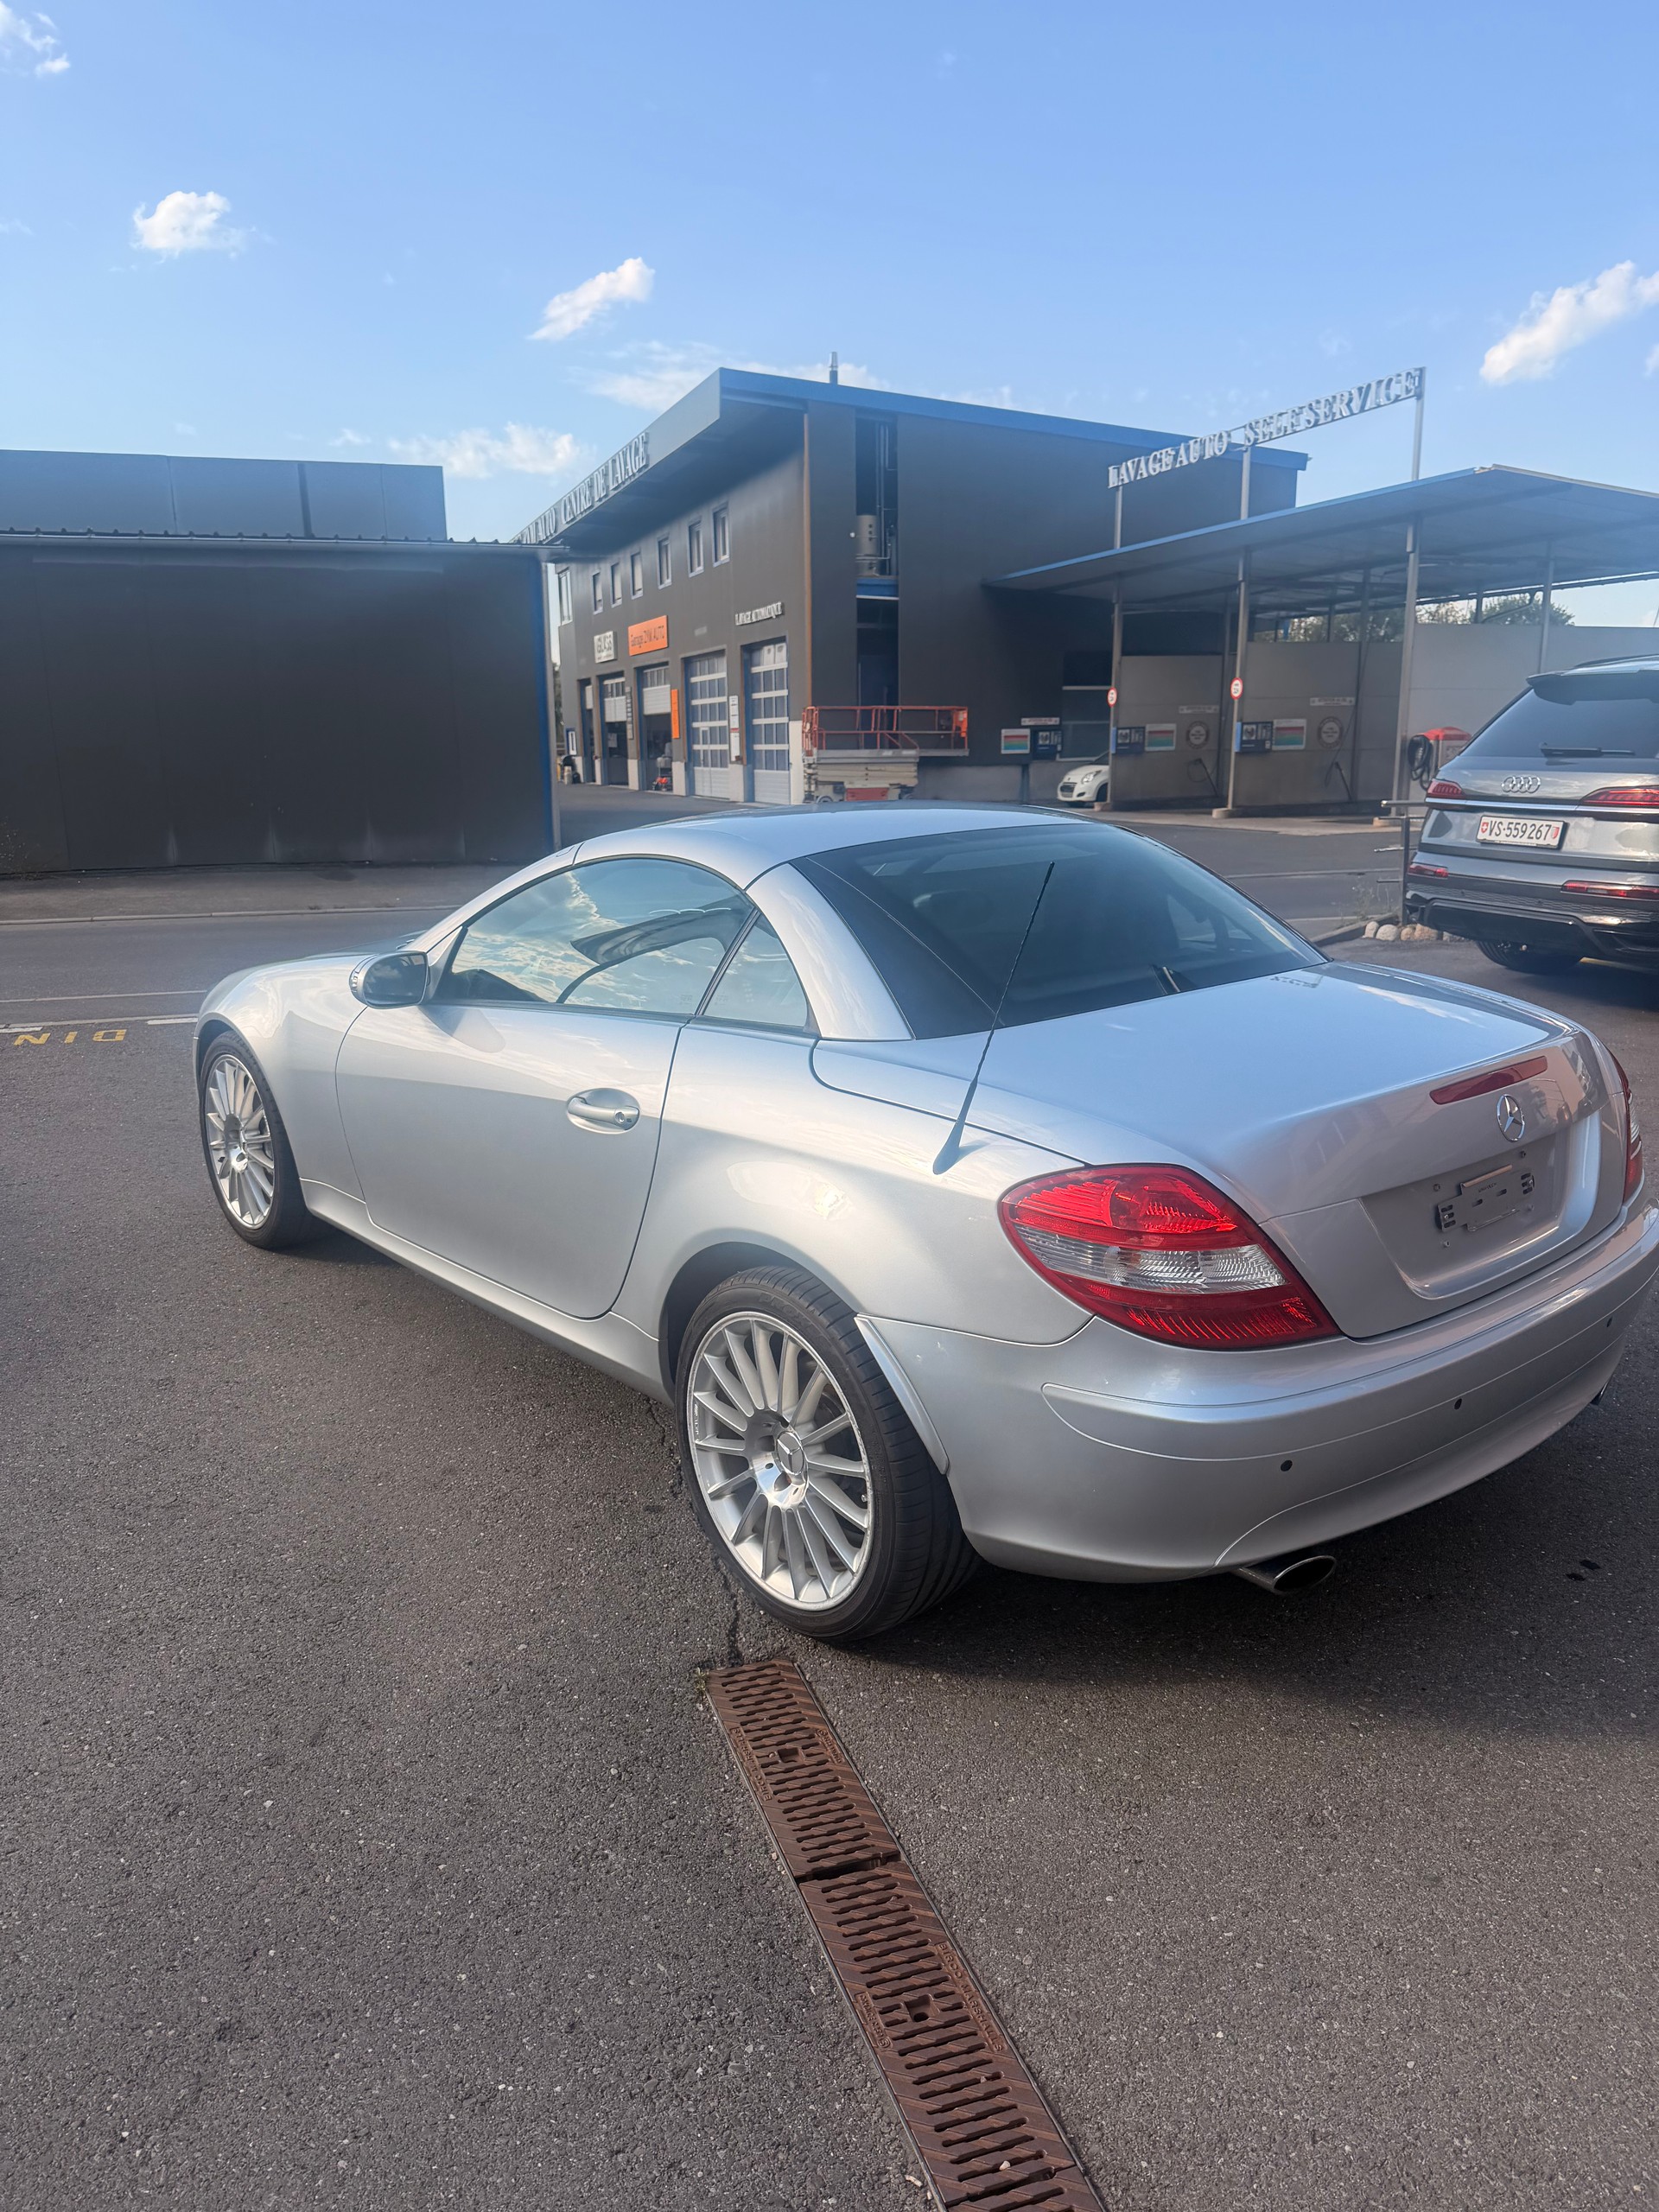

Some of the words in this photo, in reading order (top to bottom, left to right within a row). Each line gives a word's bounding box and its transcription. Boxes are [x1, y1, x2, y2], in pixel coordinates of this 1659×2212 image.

[1108, 449, 1175, 488] LAVAGE
[1175, 430, 1229, 468] AUTO
[1303, 368, 1415, 429] SERVICE
[561, 478, 593, 524] CENTRE
[594, 465, 607, 502] DE
[608, 432, 648, 491] LAVAGE
[939, 1944, 963, 1979] BIRCO
